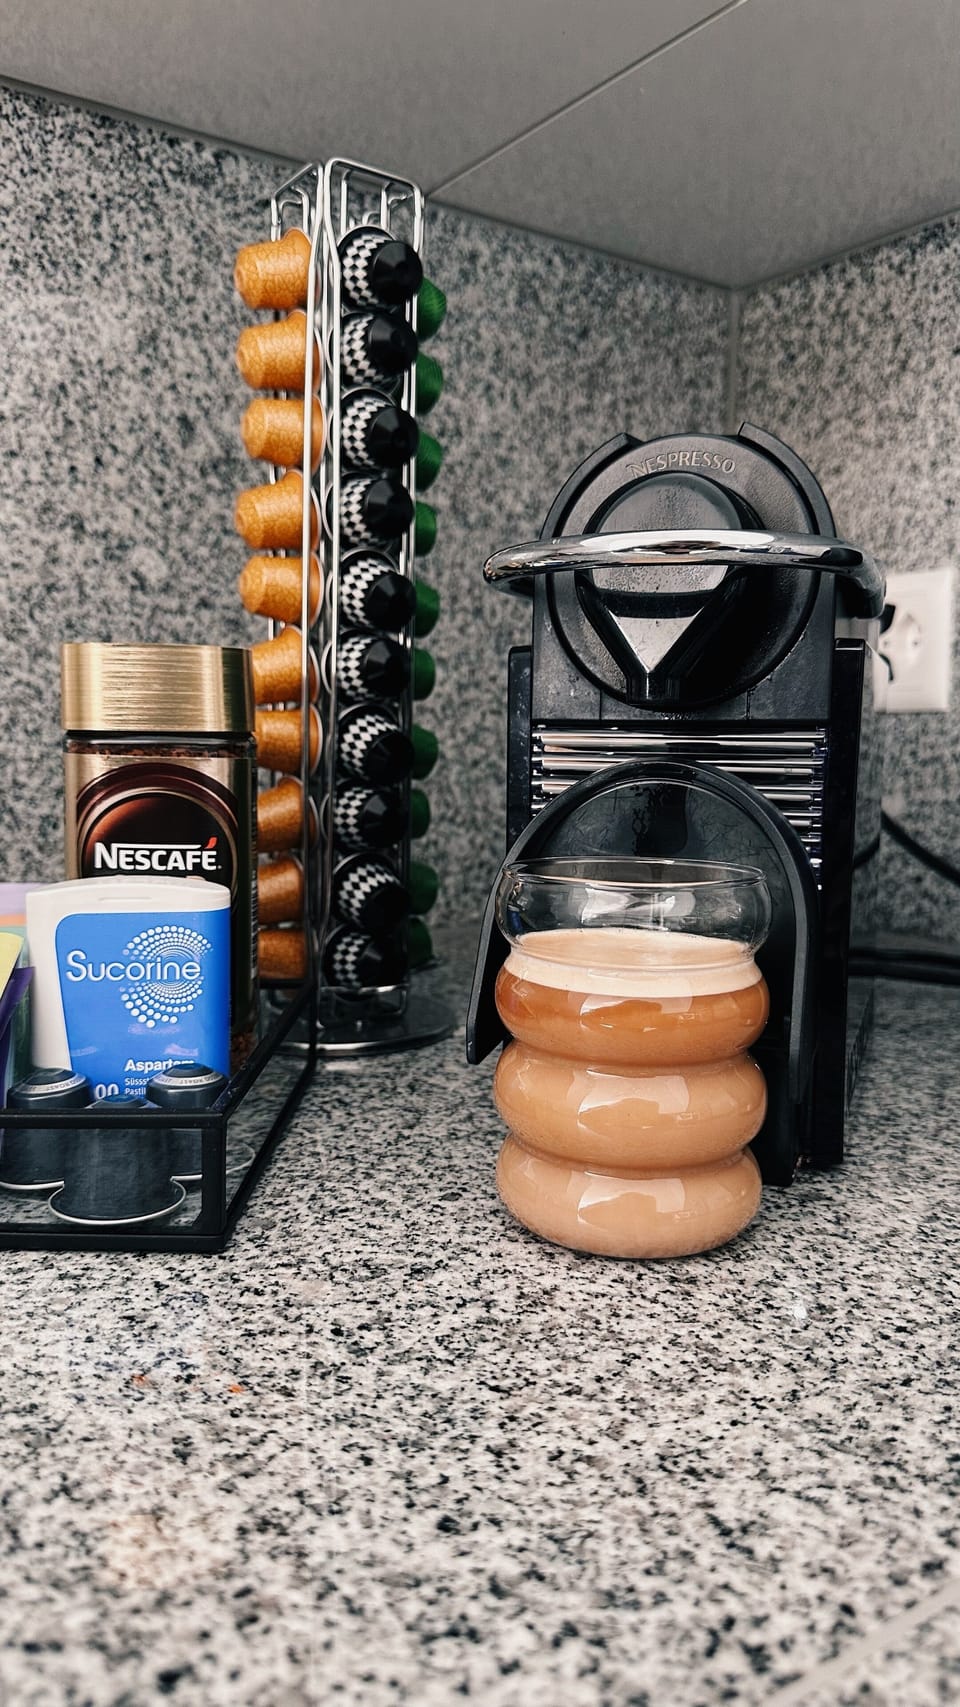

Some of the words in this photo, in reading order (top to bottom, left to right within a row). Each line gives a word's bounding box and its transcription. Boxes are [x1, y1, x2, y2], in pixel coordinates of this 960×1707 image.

[626, 451, 736, 479] NESPRESSO
[94, 837, 218, 871] NESCAFÉ
[65, 950, 201, 982] Sucorine
